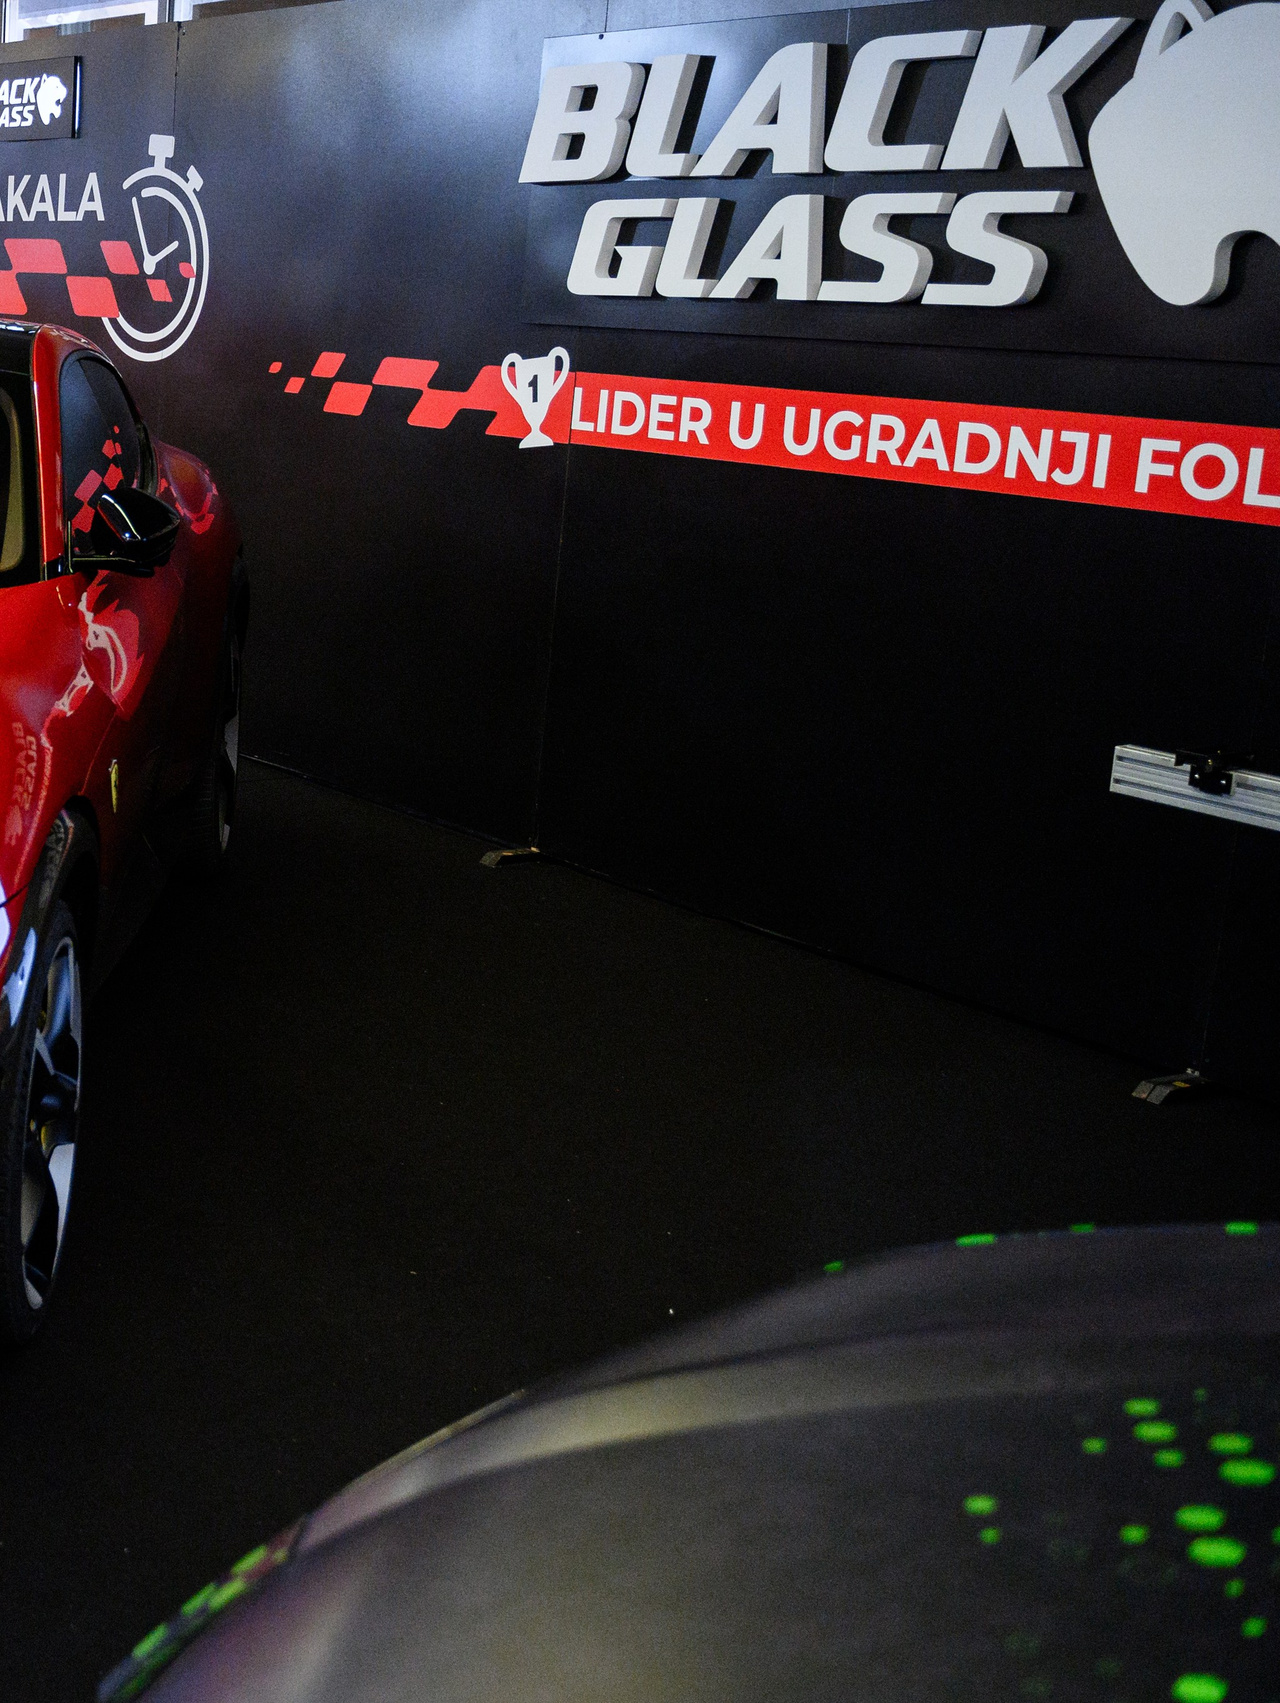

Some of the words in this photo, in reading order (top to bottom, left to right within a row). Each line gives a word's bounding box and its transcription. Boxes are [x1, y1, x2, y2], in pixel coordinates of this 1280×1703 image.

[519, 17, 1135, 185] BLACK
[566, 189, 1080, 308] GLASS
[571, 385, 711, 445] LIDER
[729, 401, 766, 450] U
[782, 407, 1112, 489] UGRADNJI
[1134, 437, 1280, 508] FOL
